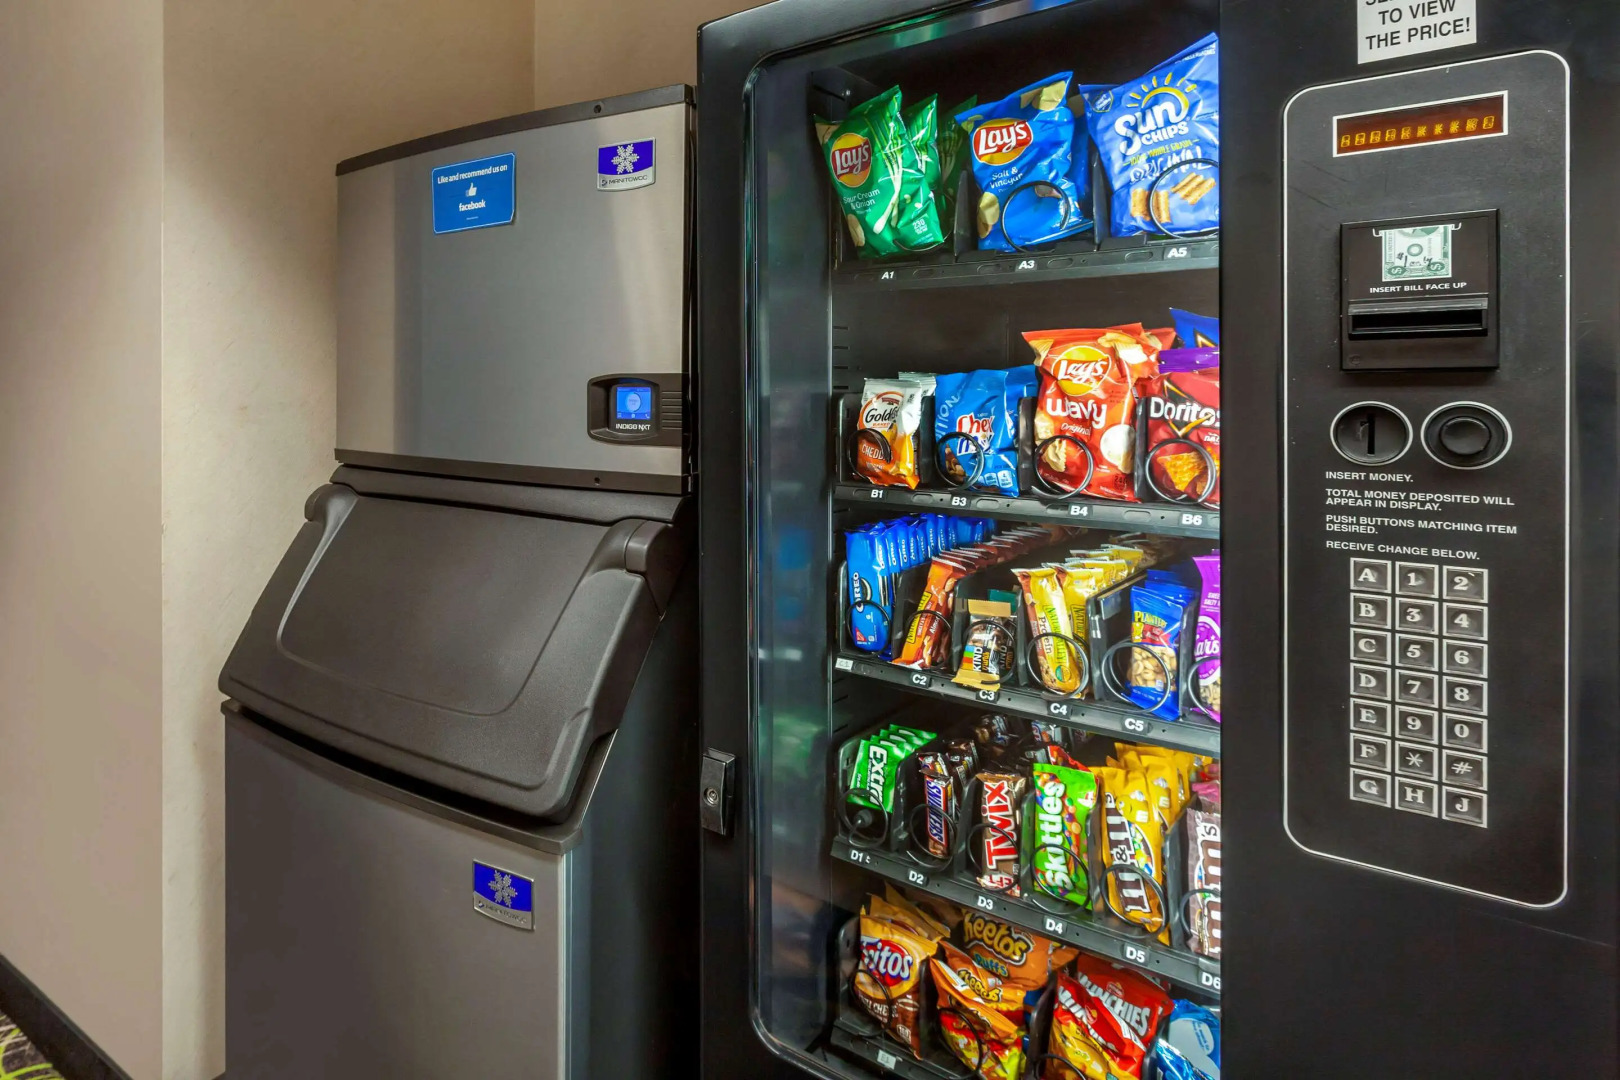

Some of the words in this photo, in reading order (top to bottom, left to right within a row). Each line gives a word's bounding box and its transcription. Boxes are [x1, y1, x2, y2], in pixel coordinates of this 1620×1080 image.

[1378, 8, 1402, 25] TO
[1409, 0, 1456, 19] VIEW
[1366, 30, 1400, 50] THE
[1408, 17, 1470, 42] PRICE!
[1114, 100, 1186, 156] Sun
[1141, 122, 1189, 146] CHIPS
[979, 122, 1028, 155] Lay's
[1170, 140, 1193, 151] GRAIN
[834, 142, 870, 175] Lay's
[438, 176, 449, 184] Like
[449, 173, 459, 182] and
[460, 166, 492, 180] recommend
[500, 164, 508, 172] on
[609, 175, 647, 184] MANITOWOC
[990, 172, 1023, 189] Vinegar
[992, 168, 1010, 181] Salt
[1011, 166, 1019, 174] &
[843, 196, 856, 204] Sour
[857, 189, 880, 200] Cream
[856, 199, 875, 208] Onion
[459, 199, 486, 212] facebook
[1168, 247, 1188, 258] A5
[1018, 260, 1035, 269] A3
[881, 271, 895, 280] A1
[1057, 358, 1107, 386] Lay's
[958, 414, 994, 434] Chex
[1060, 422, 1091, 437] Original
[1326, 471, 1366, 480] INSERT
[1369, 473, 1414, 482] MONEY.
[870, 490, 884, 498] B1
[951, 497, 967, 506] B3
[1326, 488, 1362, 498] TOTAL
[1364, 491, 1406, 500] MONEY
[1410, 493, 1480, 504] DEPOSITED
[1484, 496, 1515, 506] WILL
[1070, 505, 1088, 516] B4
[1326, 498, 1372, 507] APPEAR
[1390, 501, 1442, 511] DISPLAY.
[1182, 514, 1202, 525] B6
[1326, 515, 1356, 524] PUSH
[1360, 516, 1415, 528] BUTTONS
[1418, 521, 1483, 532] MATCHING
[1486, 524, 1517, 534] ITEM
[1326, 524, 1378, 534] DESIRED.
[1326, 541, 1374, 551] RECEIVE
[1378, 545, 1428, 556] CHANGE
[1432, 549, 1480, 560] BELOW.
[1358, 569, 1376, 583] A
[1407, 572, 1418, 586] 1
[1454, 576, 1468, 591] 2
[853, 572, 864, 613] OREO
[1359, 603, 1376, 618] B
[1406, 608, 1421, 622] 3
[1454, 613, 1469, 628] 4
[1038, 616, 1053, 654] Proein
[1358, 638, 1376, 653] C
[1407, 644, 1421, 658] 5
[973, 647, 982, 672] KIND
[1454, 650, 1470, 665] 6
[912, 674, 927, 685] C2
[1359, 673, 1376, 688] D
[1406, 680, 1421, 694] 7
[980, 690, 994, 700] C3
[1454, 688, 1470, 702] 8
[1050, 702, 1067, 715] C4
[1359, 709, 1376, 723] E
[1125, 718, 1144, 732] C5
[1407, 716, 1421, 730] 9
[1454, 724, 1469, 738] 0
[1359, 744, 1376, 758] F
[1359, 780, 1378, 794] G
[1405, 788, 1424, 804] H
[926, 780, 943, 843] SNICKERS
[1455, 797, 1470, 812] J
[1044, 781, 1074, 891] Skittles
[909, 871, 924, 884] D2
[977, 896, 994, 910] D3
[1045, 919, 1063, 934] D4
[964, 912, 1030, 961] heetos
[1126, 947, 1145, 963] D5
[974, 952, 1009, 978] Puffs
[1202, 971, 1220, 989] D6
